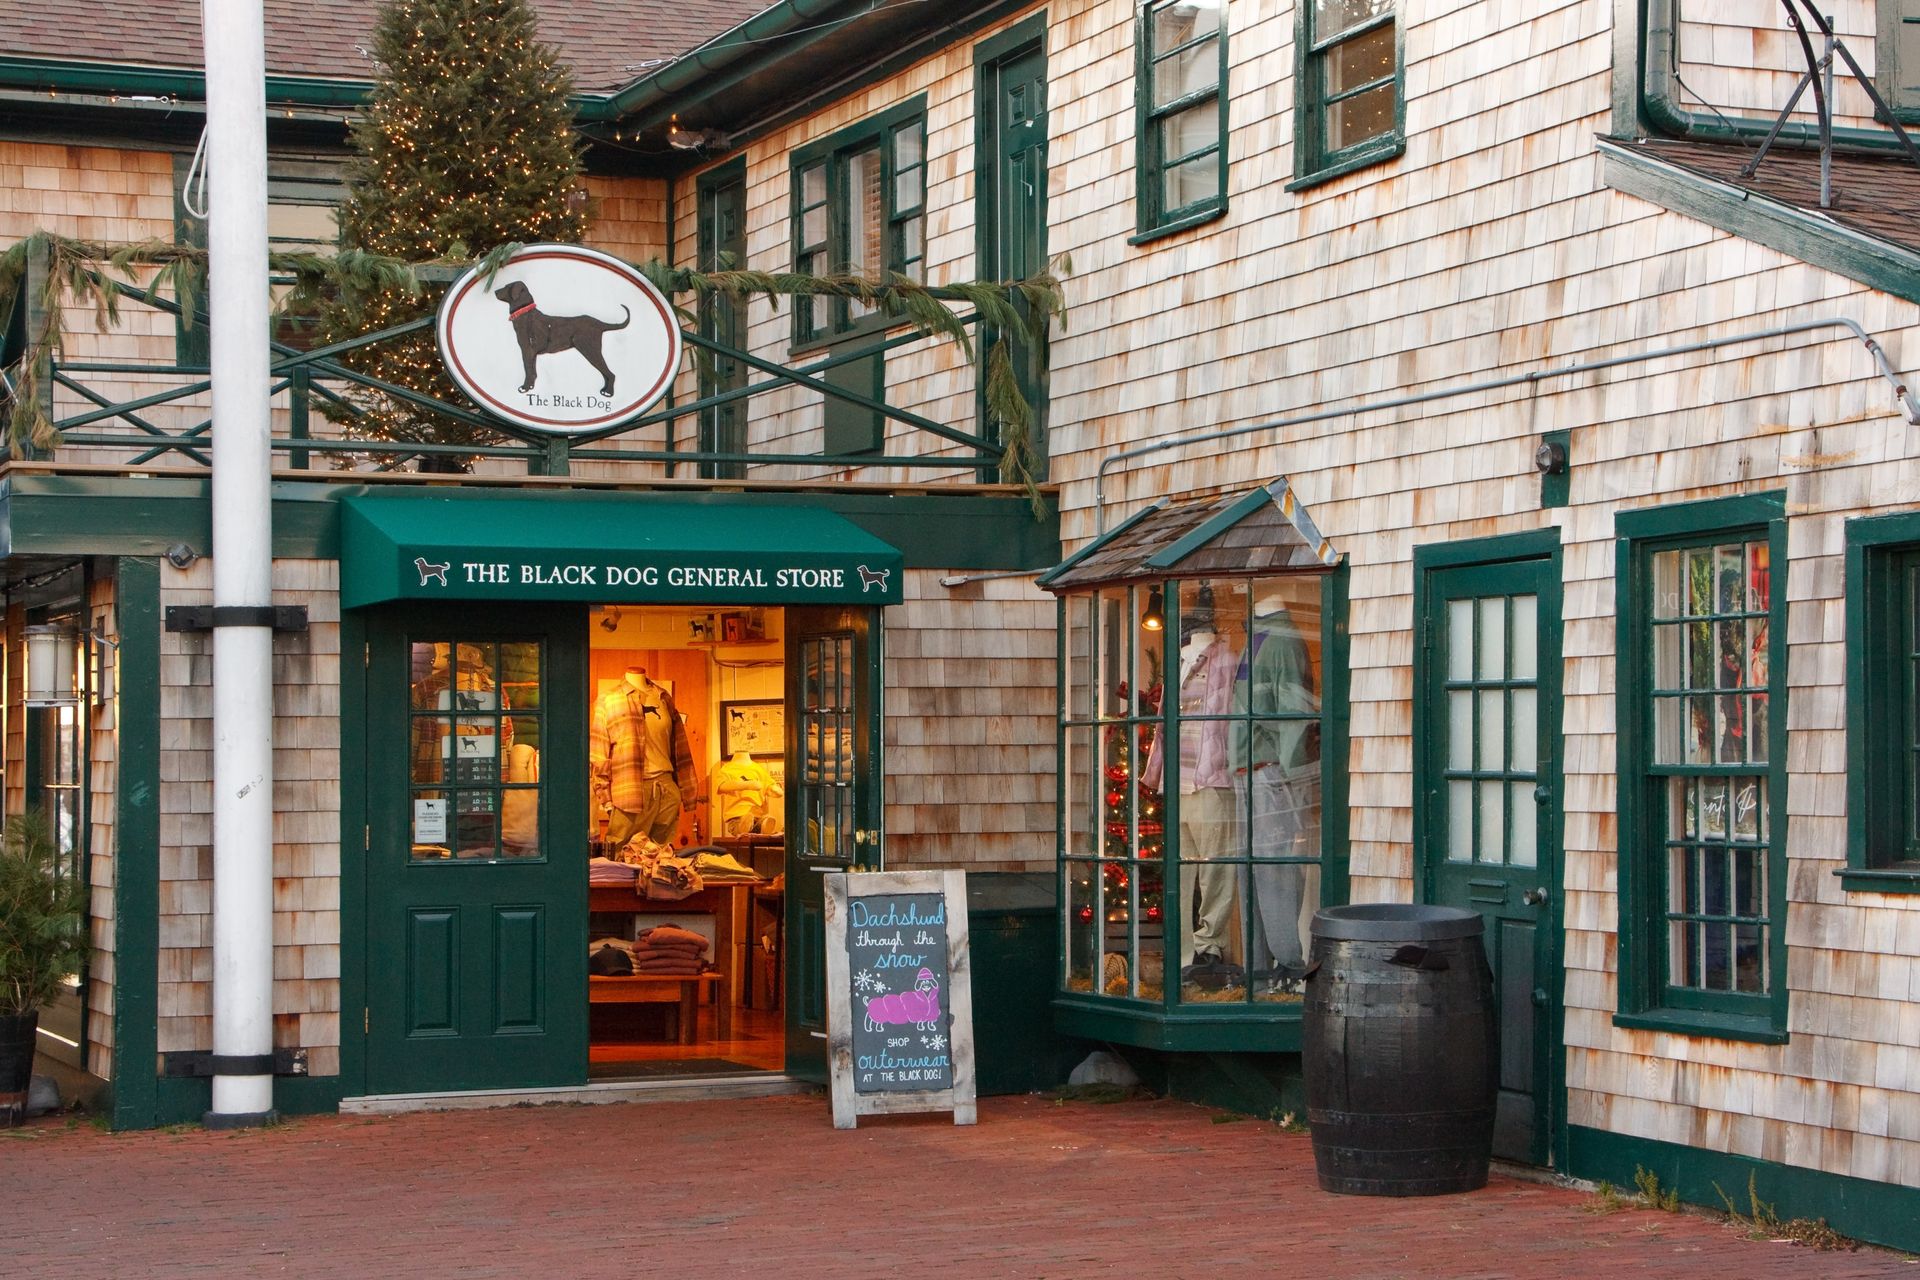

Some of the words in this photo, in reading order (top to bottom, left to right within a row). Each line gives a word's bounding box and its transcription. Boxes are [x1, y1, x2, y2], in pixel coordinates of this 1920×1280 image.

[526, 393, 549, 407] The
[552, 395, 583, 408] Black
[586, 396, 612, 410] Dog
[463, 563, 510, 583] THE
[521, 565, 597, 585] BLACK
[606, 566, 659, 586] DOG
[667, 567, 768, 587] GENERAL
[776, 569, 844, 588] STORE
[851, 901, 945, 928] Dachshund
[855, 930, 905, 952] through
[913, 930, 937, 946] the
[873, 953, 928, 970] snow
[886, 1037, 911, 1048] SHOP
[858, 1048, 950, 1070] outerwear
[862, 1073, 873, 1083] AT
[880, 1072, 896, 1082] THE
[899, 1070, 922, 1081] BLACK
[924, 1070, 942, 1081] DOG!
